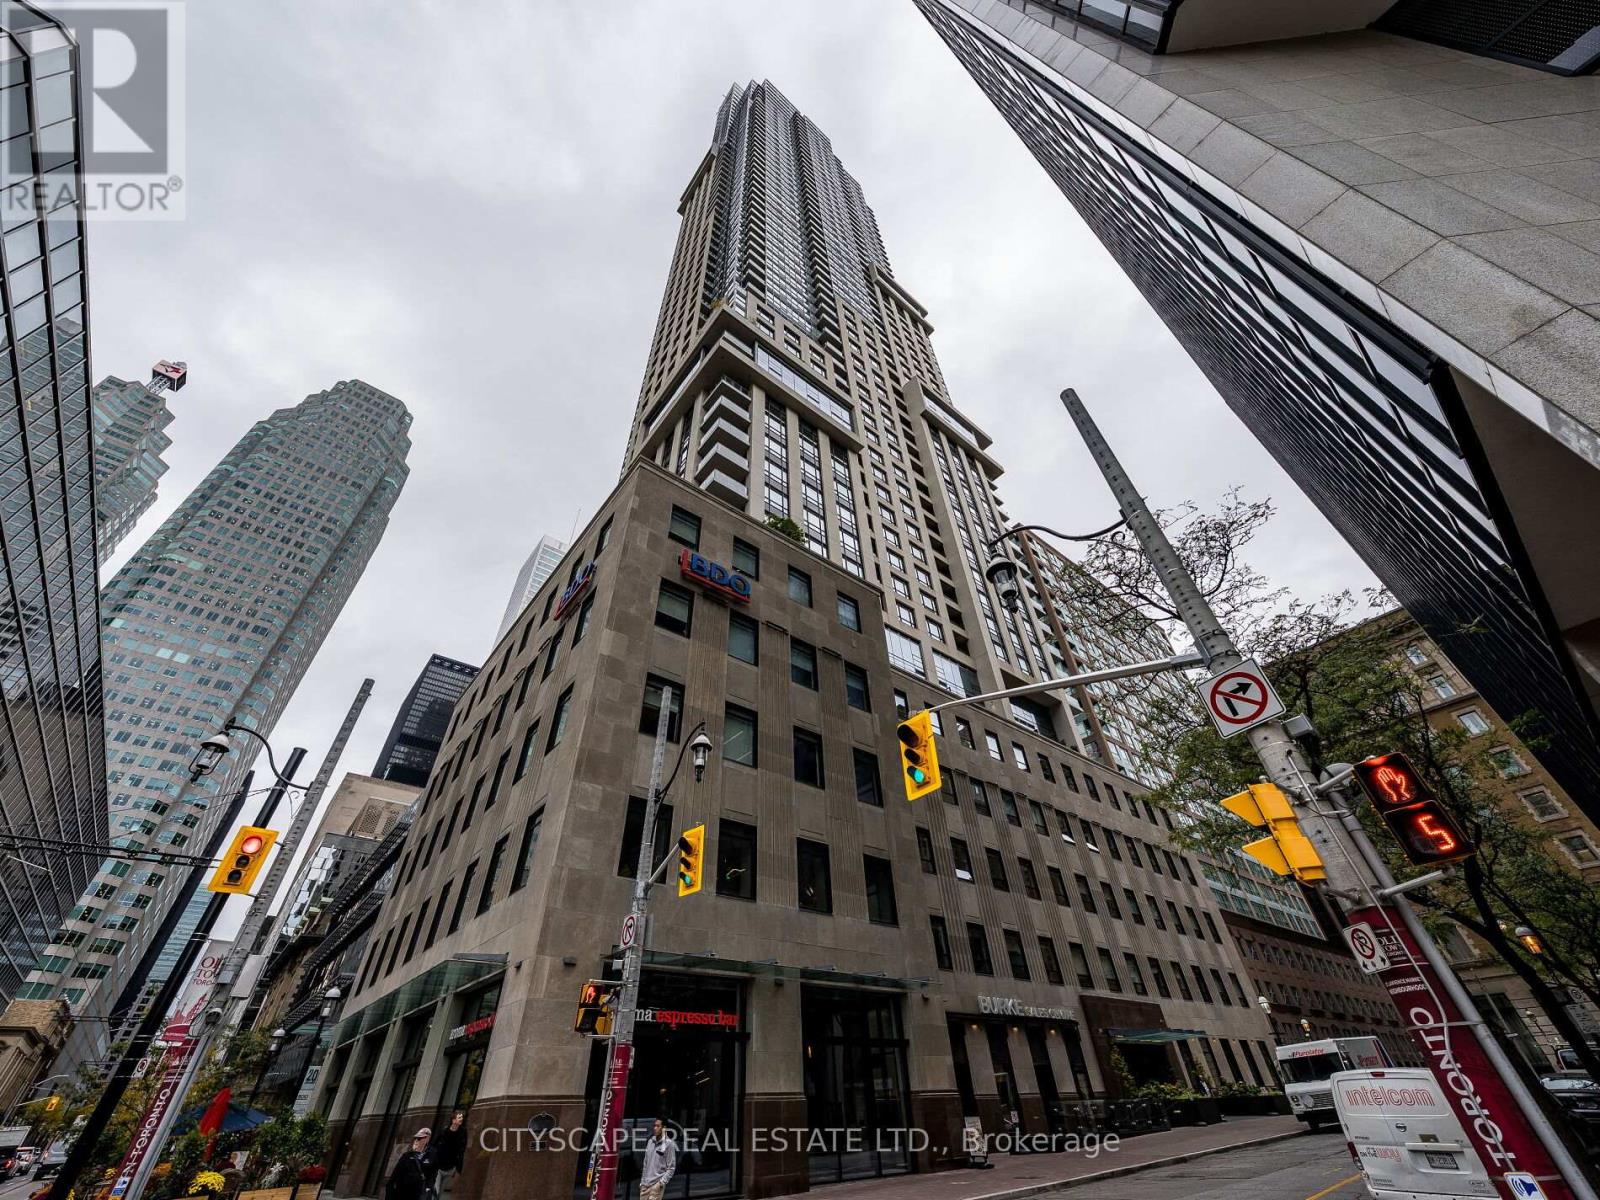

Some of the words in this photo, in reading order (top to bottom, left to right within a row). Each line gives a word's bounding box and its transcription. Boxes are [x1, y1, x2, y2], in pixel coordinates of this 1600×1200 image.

[690, 553, 751, 597] BDO
[1418, 815, 1455, 850] 5
[656, 1010, 716, 1029] espresso
[978, 995, 1024, 1016] BURKE
[1346, 1086, 1436, 1107] intelcom
[1409, 1007, 1516, 1168] TORONTO
[131, 1089, 171, 1160] TORONTO
